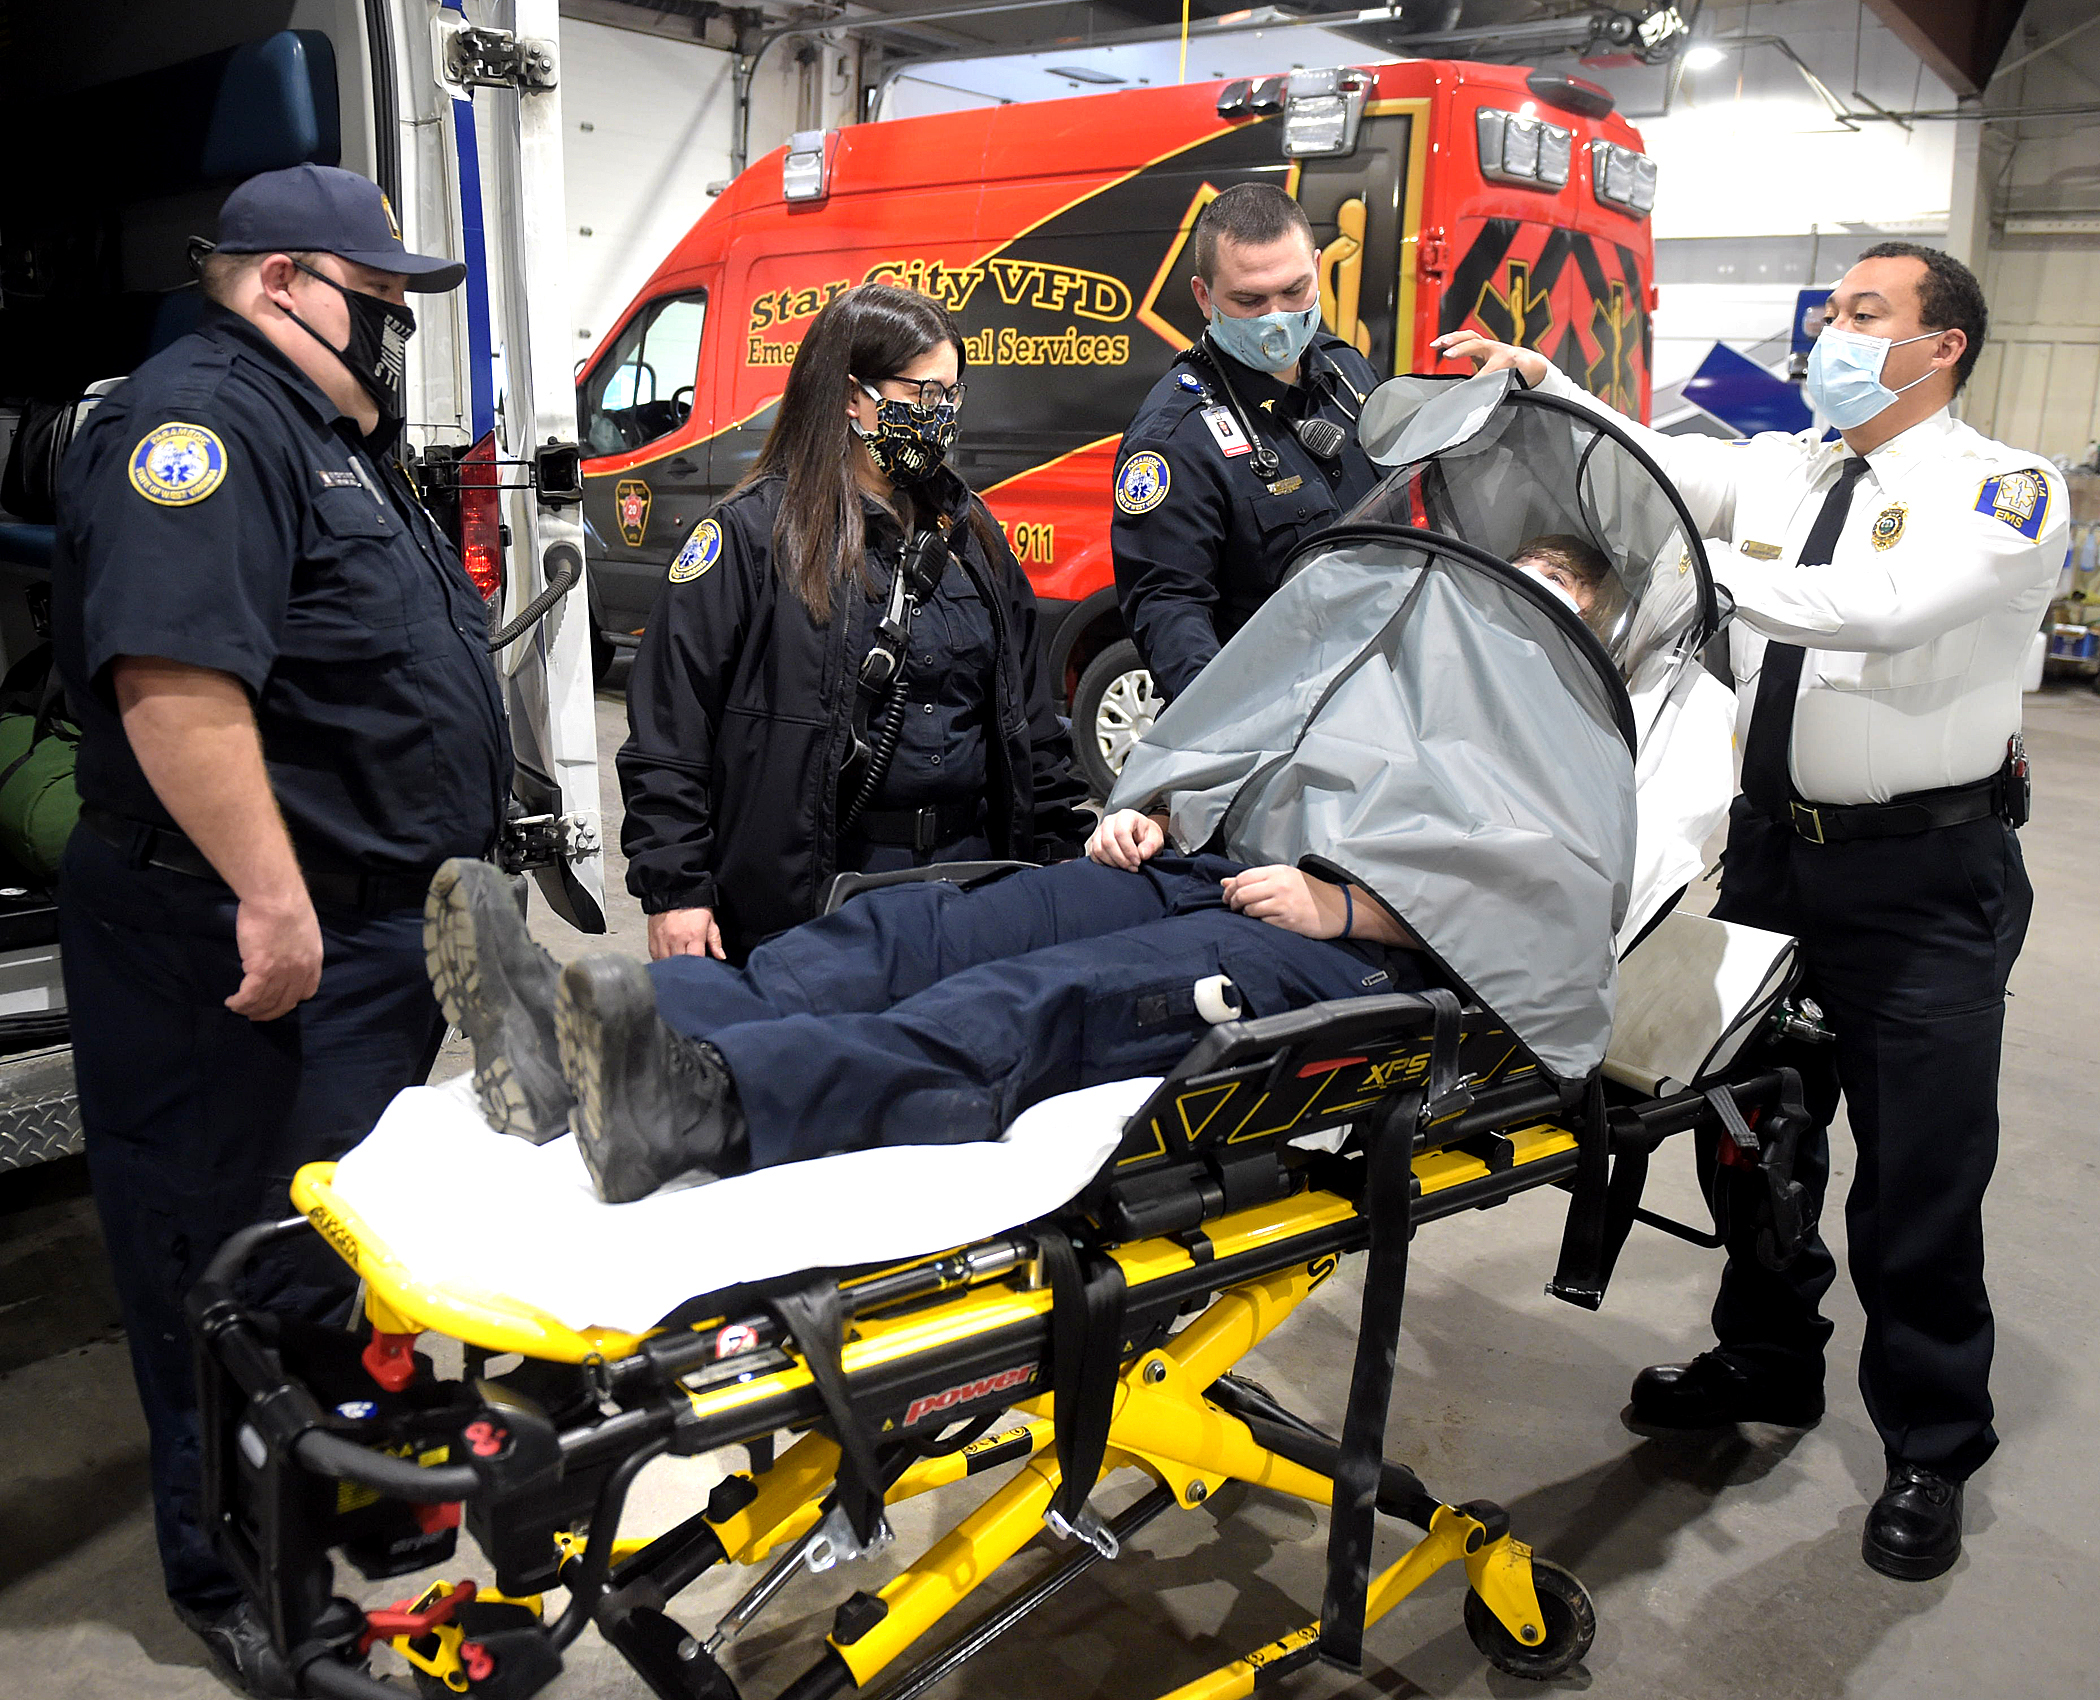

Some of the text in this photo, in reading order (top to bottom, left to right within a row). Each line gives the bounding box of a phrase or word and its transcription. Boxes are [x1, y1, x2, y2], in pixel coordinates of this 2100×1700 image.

[749, 258, 1133, 334] Star City VFD
[997, 325, 1129, 365] Services
[628, 505, 637, 515] 20
[1993, 509, 2023, 529] EMS
[1014, 521, 1054, 564] 911
[1361, 1052, 1431, 1085] XPS
[902, 1361, 1038, 1428] power
